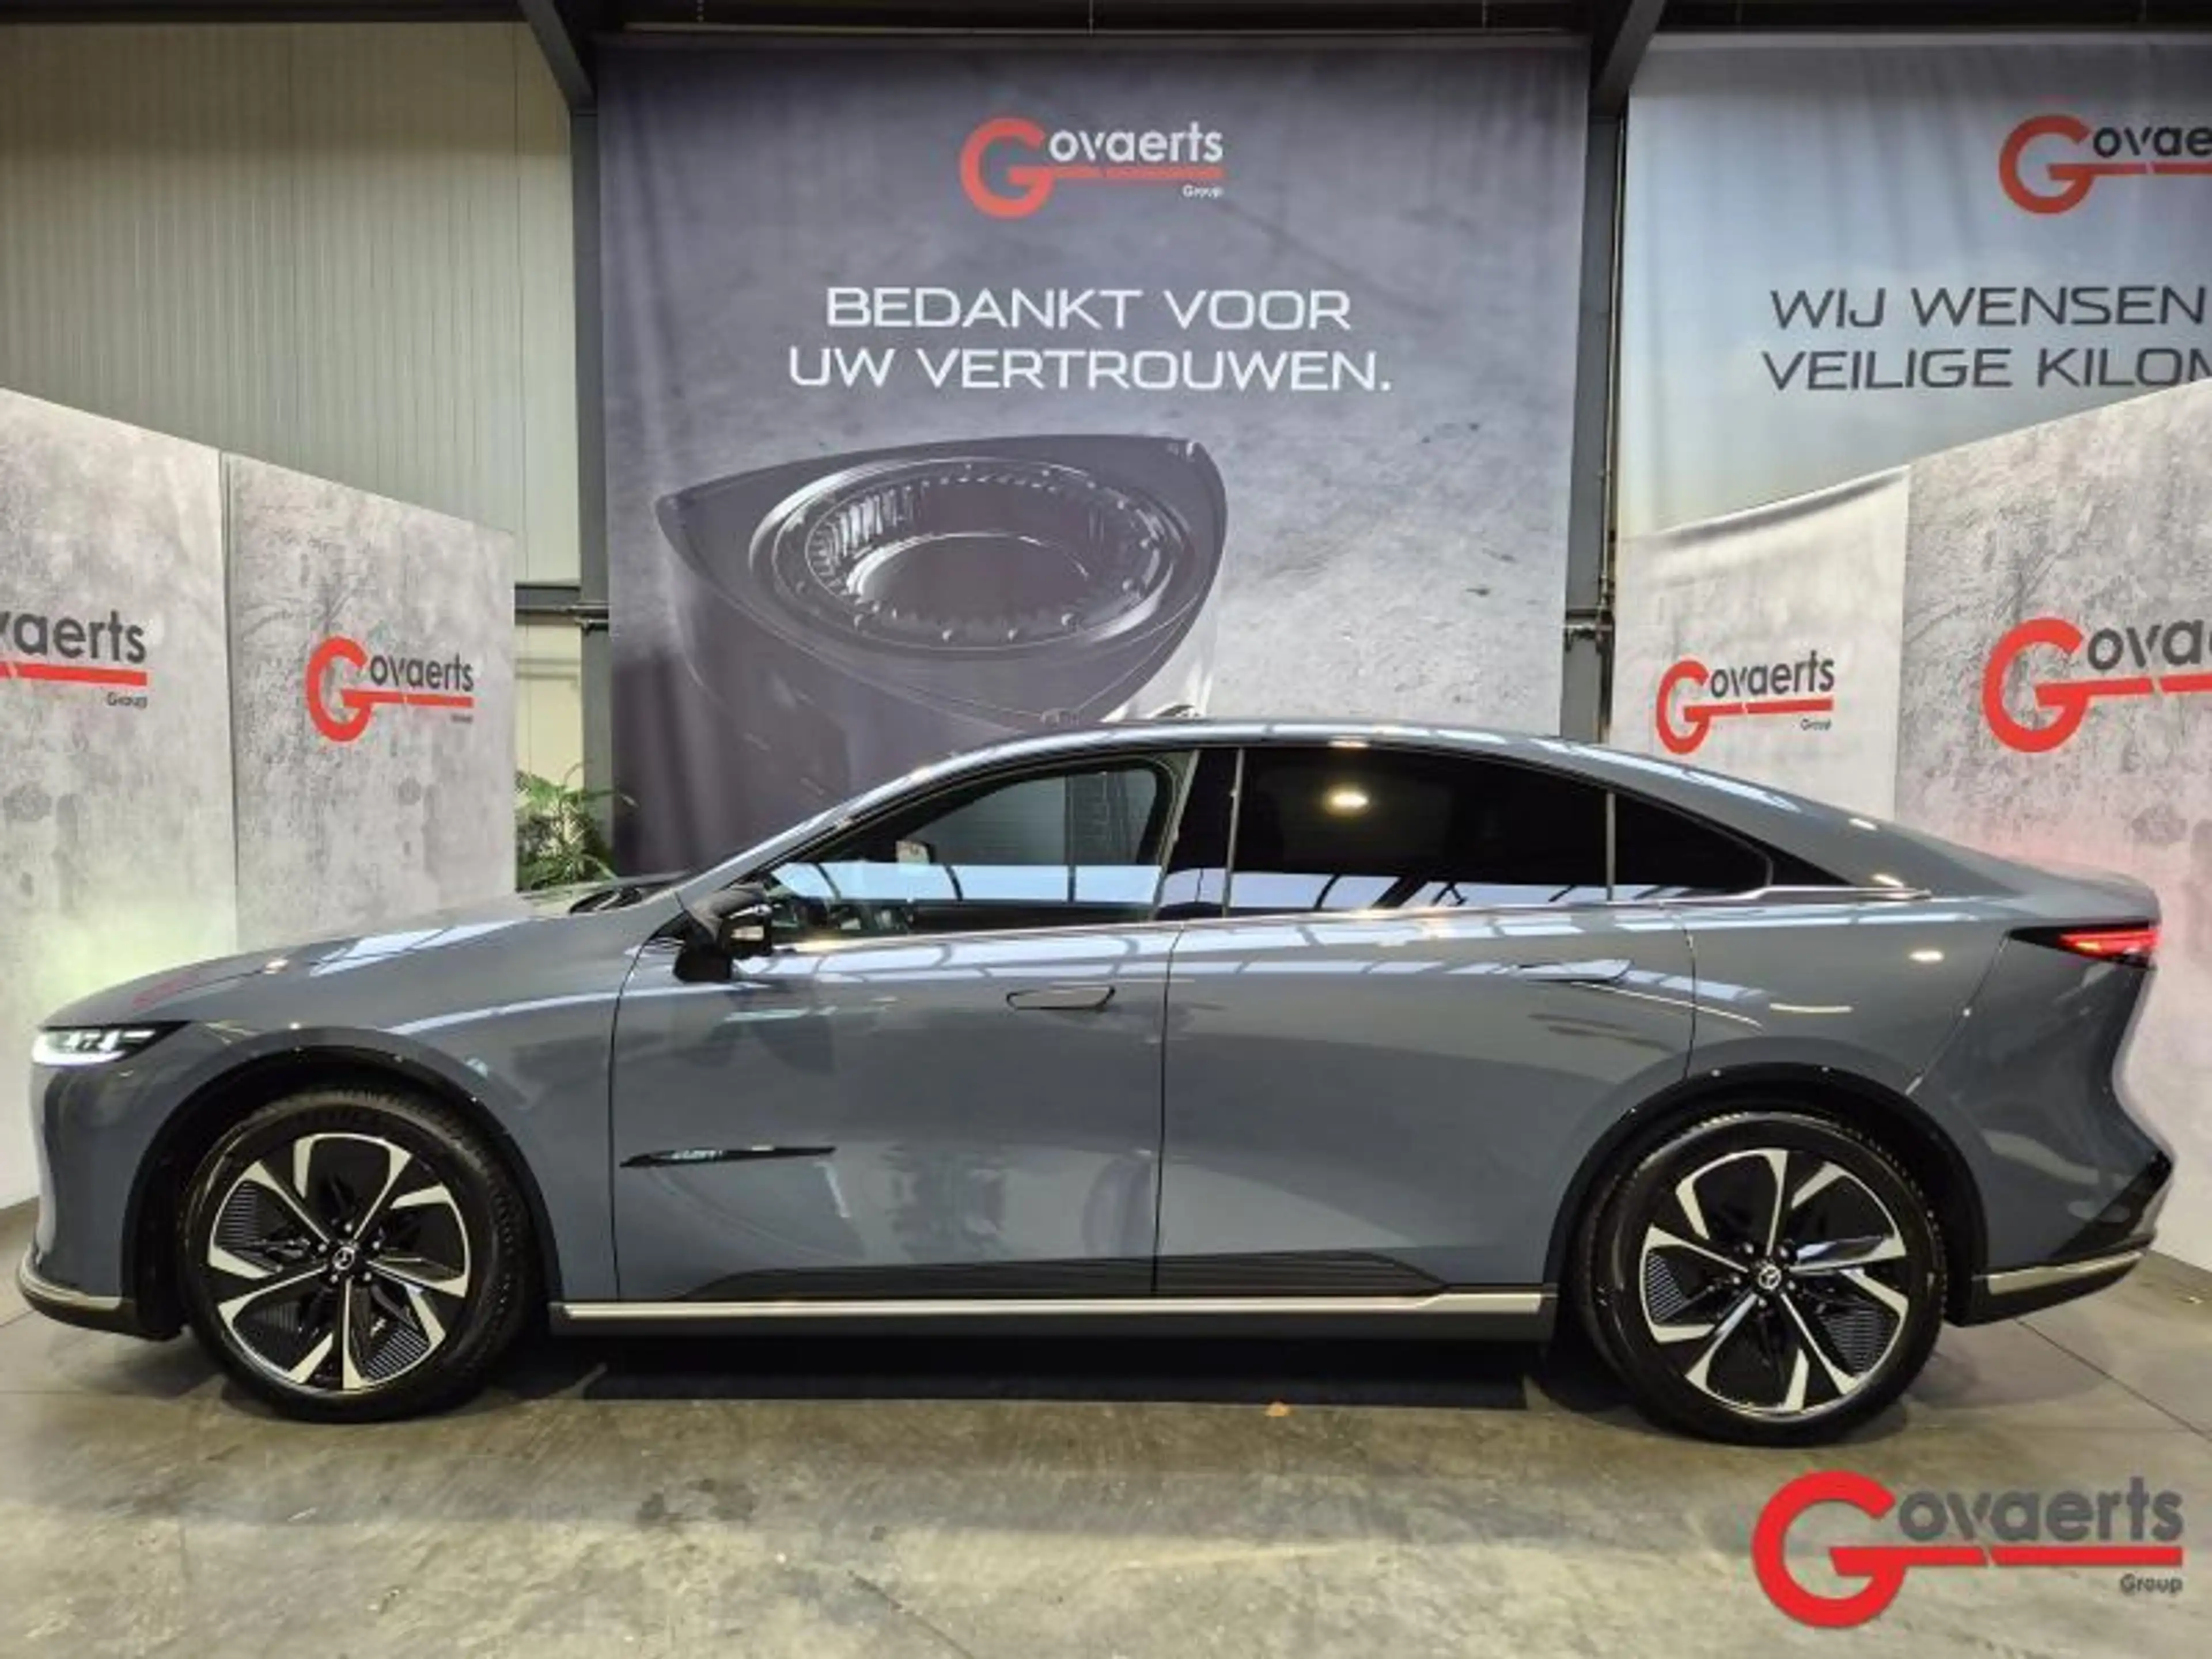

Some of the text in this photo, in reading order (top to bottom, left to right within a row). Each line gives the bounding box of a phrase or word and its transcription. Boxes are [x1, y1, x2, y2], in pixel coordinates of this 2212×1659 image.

[960, 118, 1224, 219] Govaerts
[827, 287, 1350, 329] BEDANKT VOOR
[1770, 285, 2205, 328] WIJ WENSEN
[790, 346, 1392, 392] UW VERTROUWEN.
[1762, 347, 2013, 390] VEILIGE
[306, 636, 474, 742] Govaerts
[1656, 650, 1835, 754] Govaerts
[1982, 618, 2212, 753] Gova
